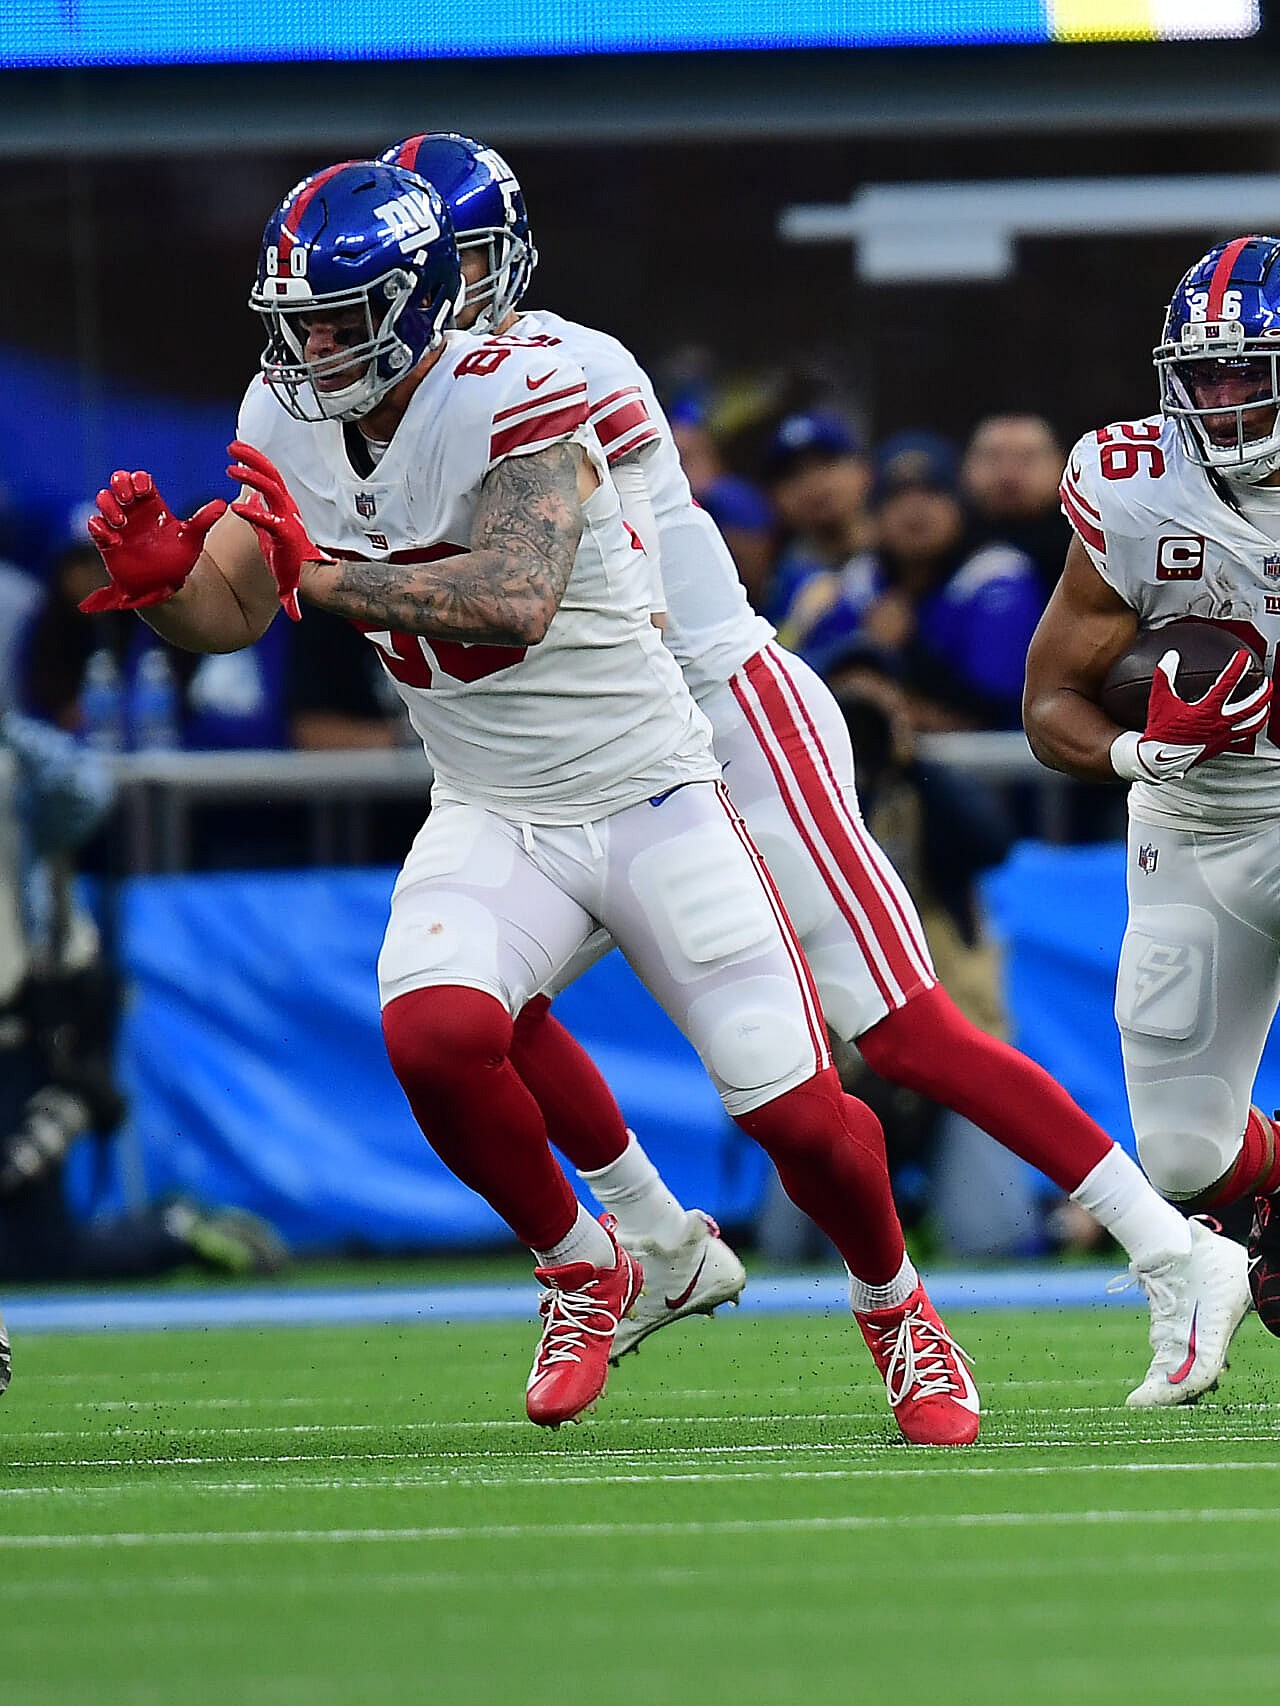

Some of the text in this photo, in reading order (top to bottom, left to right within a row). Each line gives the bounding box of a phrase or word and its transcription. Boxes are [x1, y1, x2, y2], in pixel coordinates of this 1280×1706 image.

[266, 245, 308, 278] 80
[1190, 290, 1243, 323] 26
[1160, 543, 1201, 568] C
